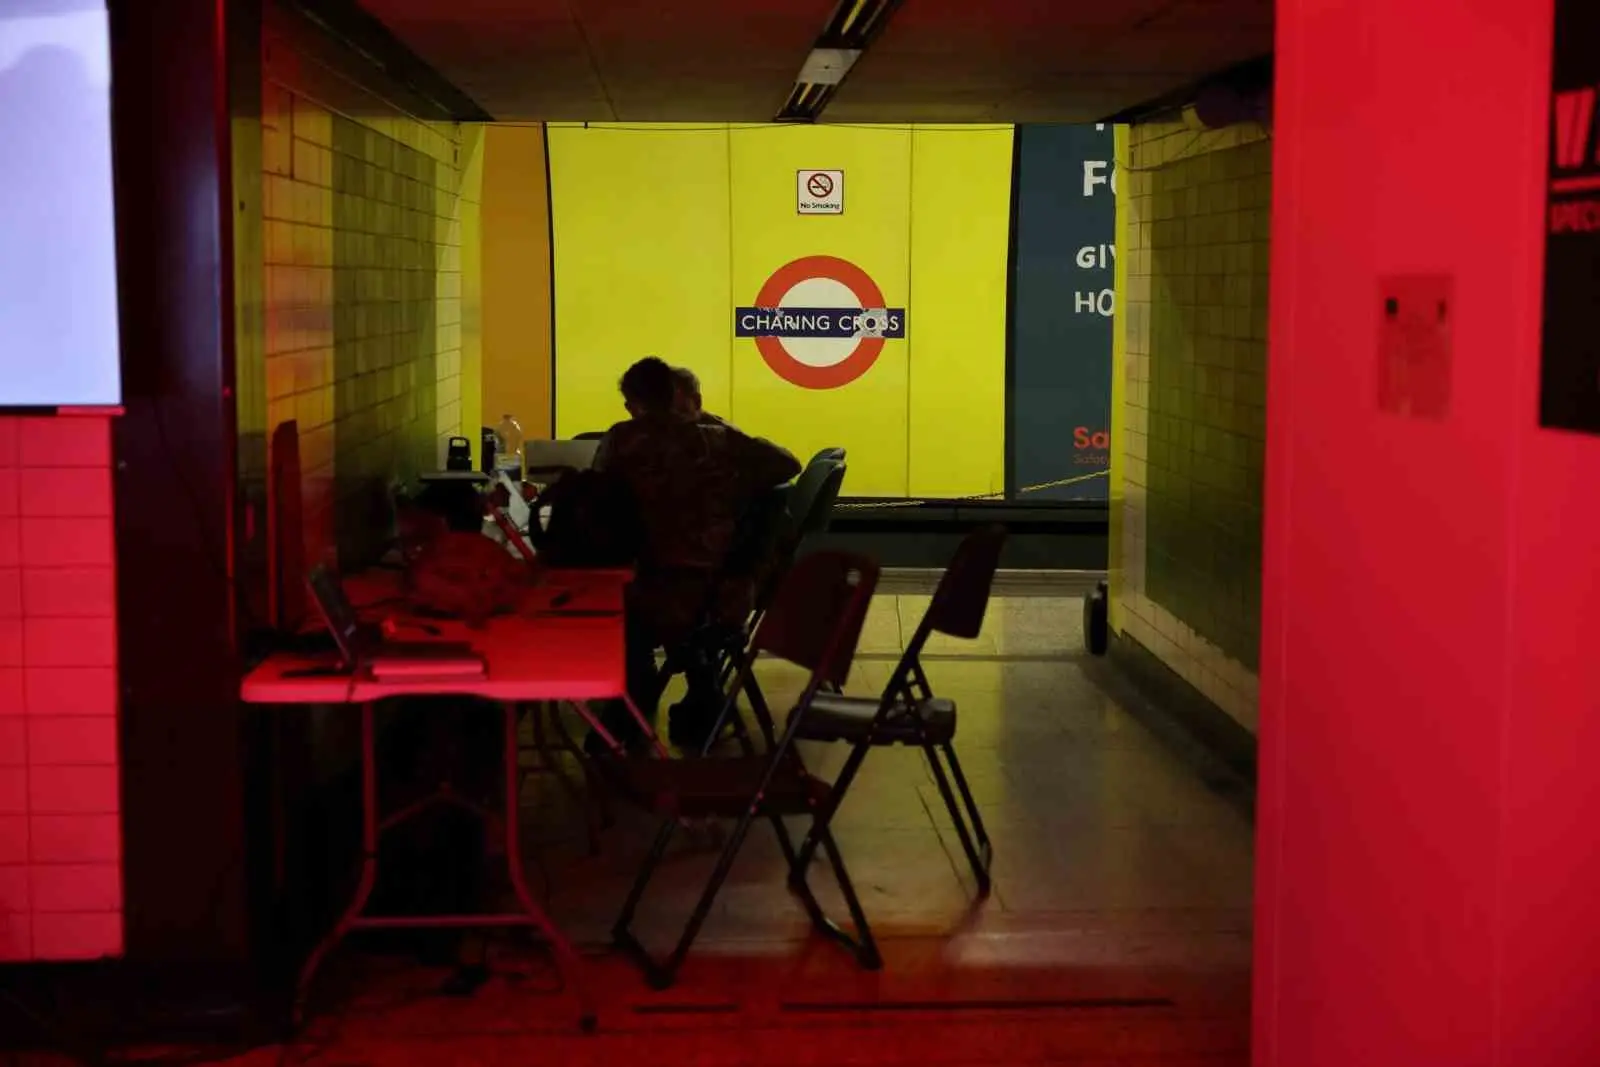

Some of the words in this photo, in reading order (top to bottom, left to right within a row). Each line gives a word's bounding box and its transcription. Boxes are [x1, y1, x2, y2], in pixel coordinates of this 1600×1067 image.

[1083, 160, 1117, 197] F
[812, 202, 840, 210] Smoking
[741, 314, 830, 331] CHARING
[838, 314, 900, 331] CROSS
